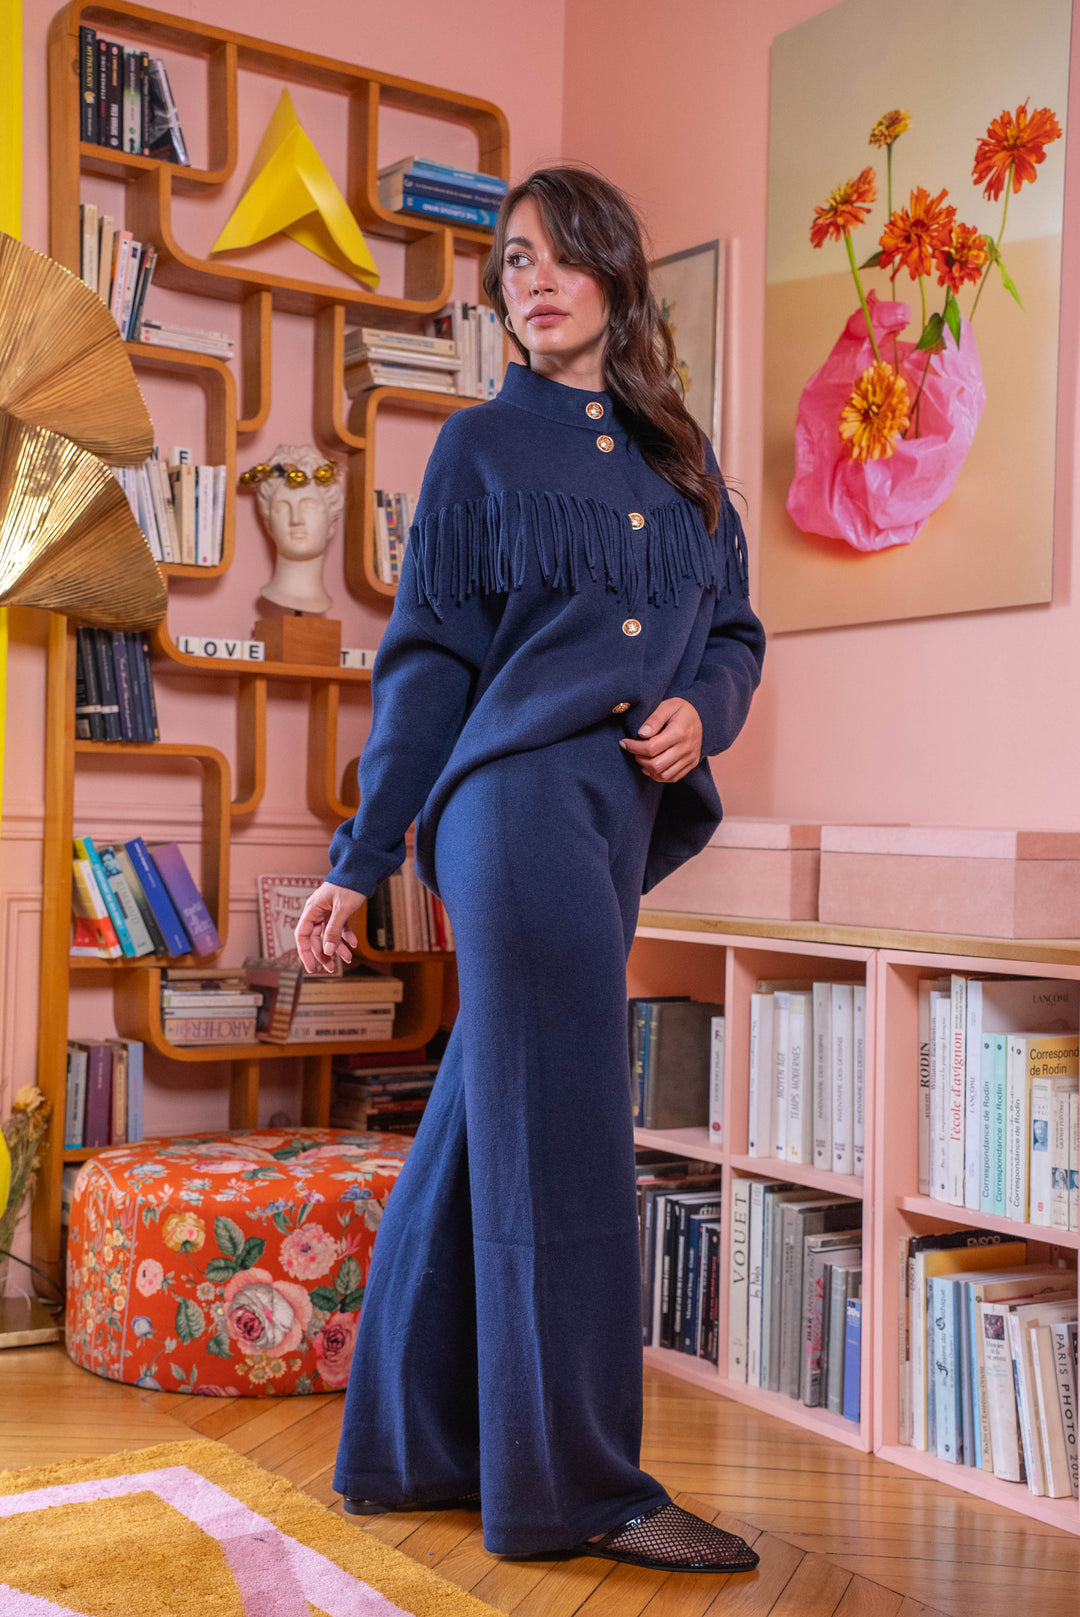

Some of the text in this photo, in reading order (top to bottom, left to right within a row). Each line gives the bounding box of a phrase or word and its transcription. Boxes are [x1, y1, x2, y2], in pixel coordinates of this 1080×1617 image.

[185, 639, 259, 659] LOVE
[191, 1020, 252, 1039] ARCHER
[790, 1046, 800, 1120] TEMPS MODERNES
[919, 1042, 930, 1088] RODIN
[1030, 1064, 1067, 1076] de Rodin
[776, 1069, 785, 1099] MOYEN
[950, 1032, 964, 1141] l'école d'avignon
[982, 1109, 990, 1122] de
[995, 1112, 1002, 1124] de
[1013, 1123, 1020, 1134] de
[982, 1124, 990, 1198] Correspondance
[995, 1126, 1003, 1203] Correspondance
[1013, 1136, 1021, 1208] Correspondance
[733, 1192, 746, 1284] VOUET
[967, 1236, 1000, 1248] ENSOR
[940, 1333, 946, 1343] du
[1055, 1333, 1068, 1375] PARIS
[1061, 1383, 1076, 1445] PHOTO
